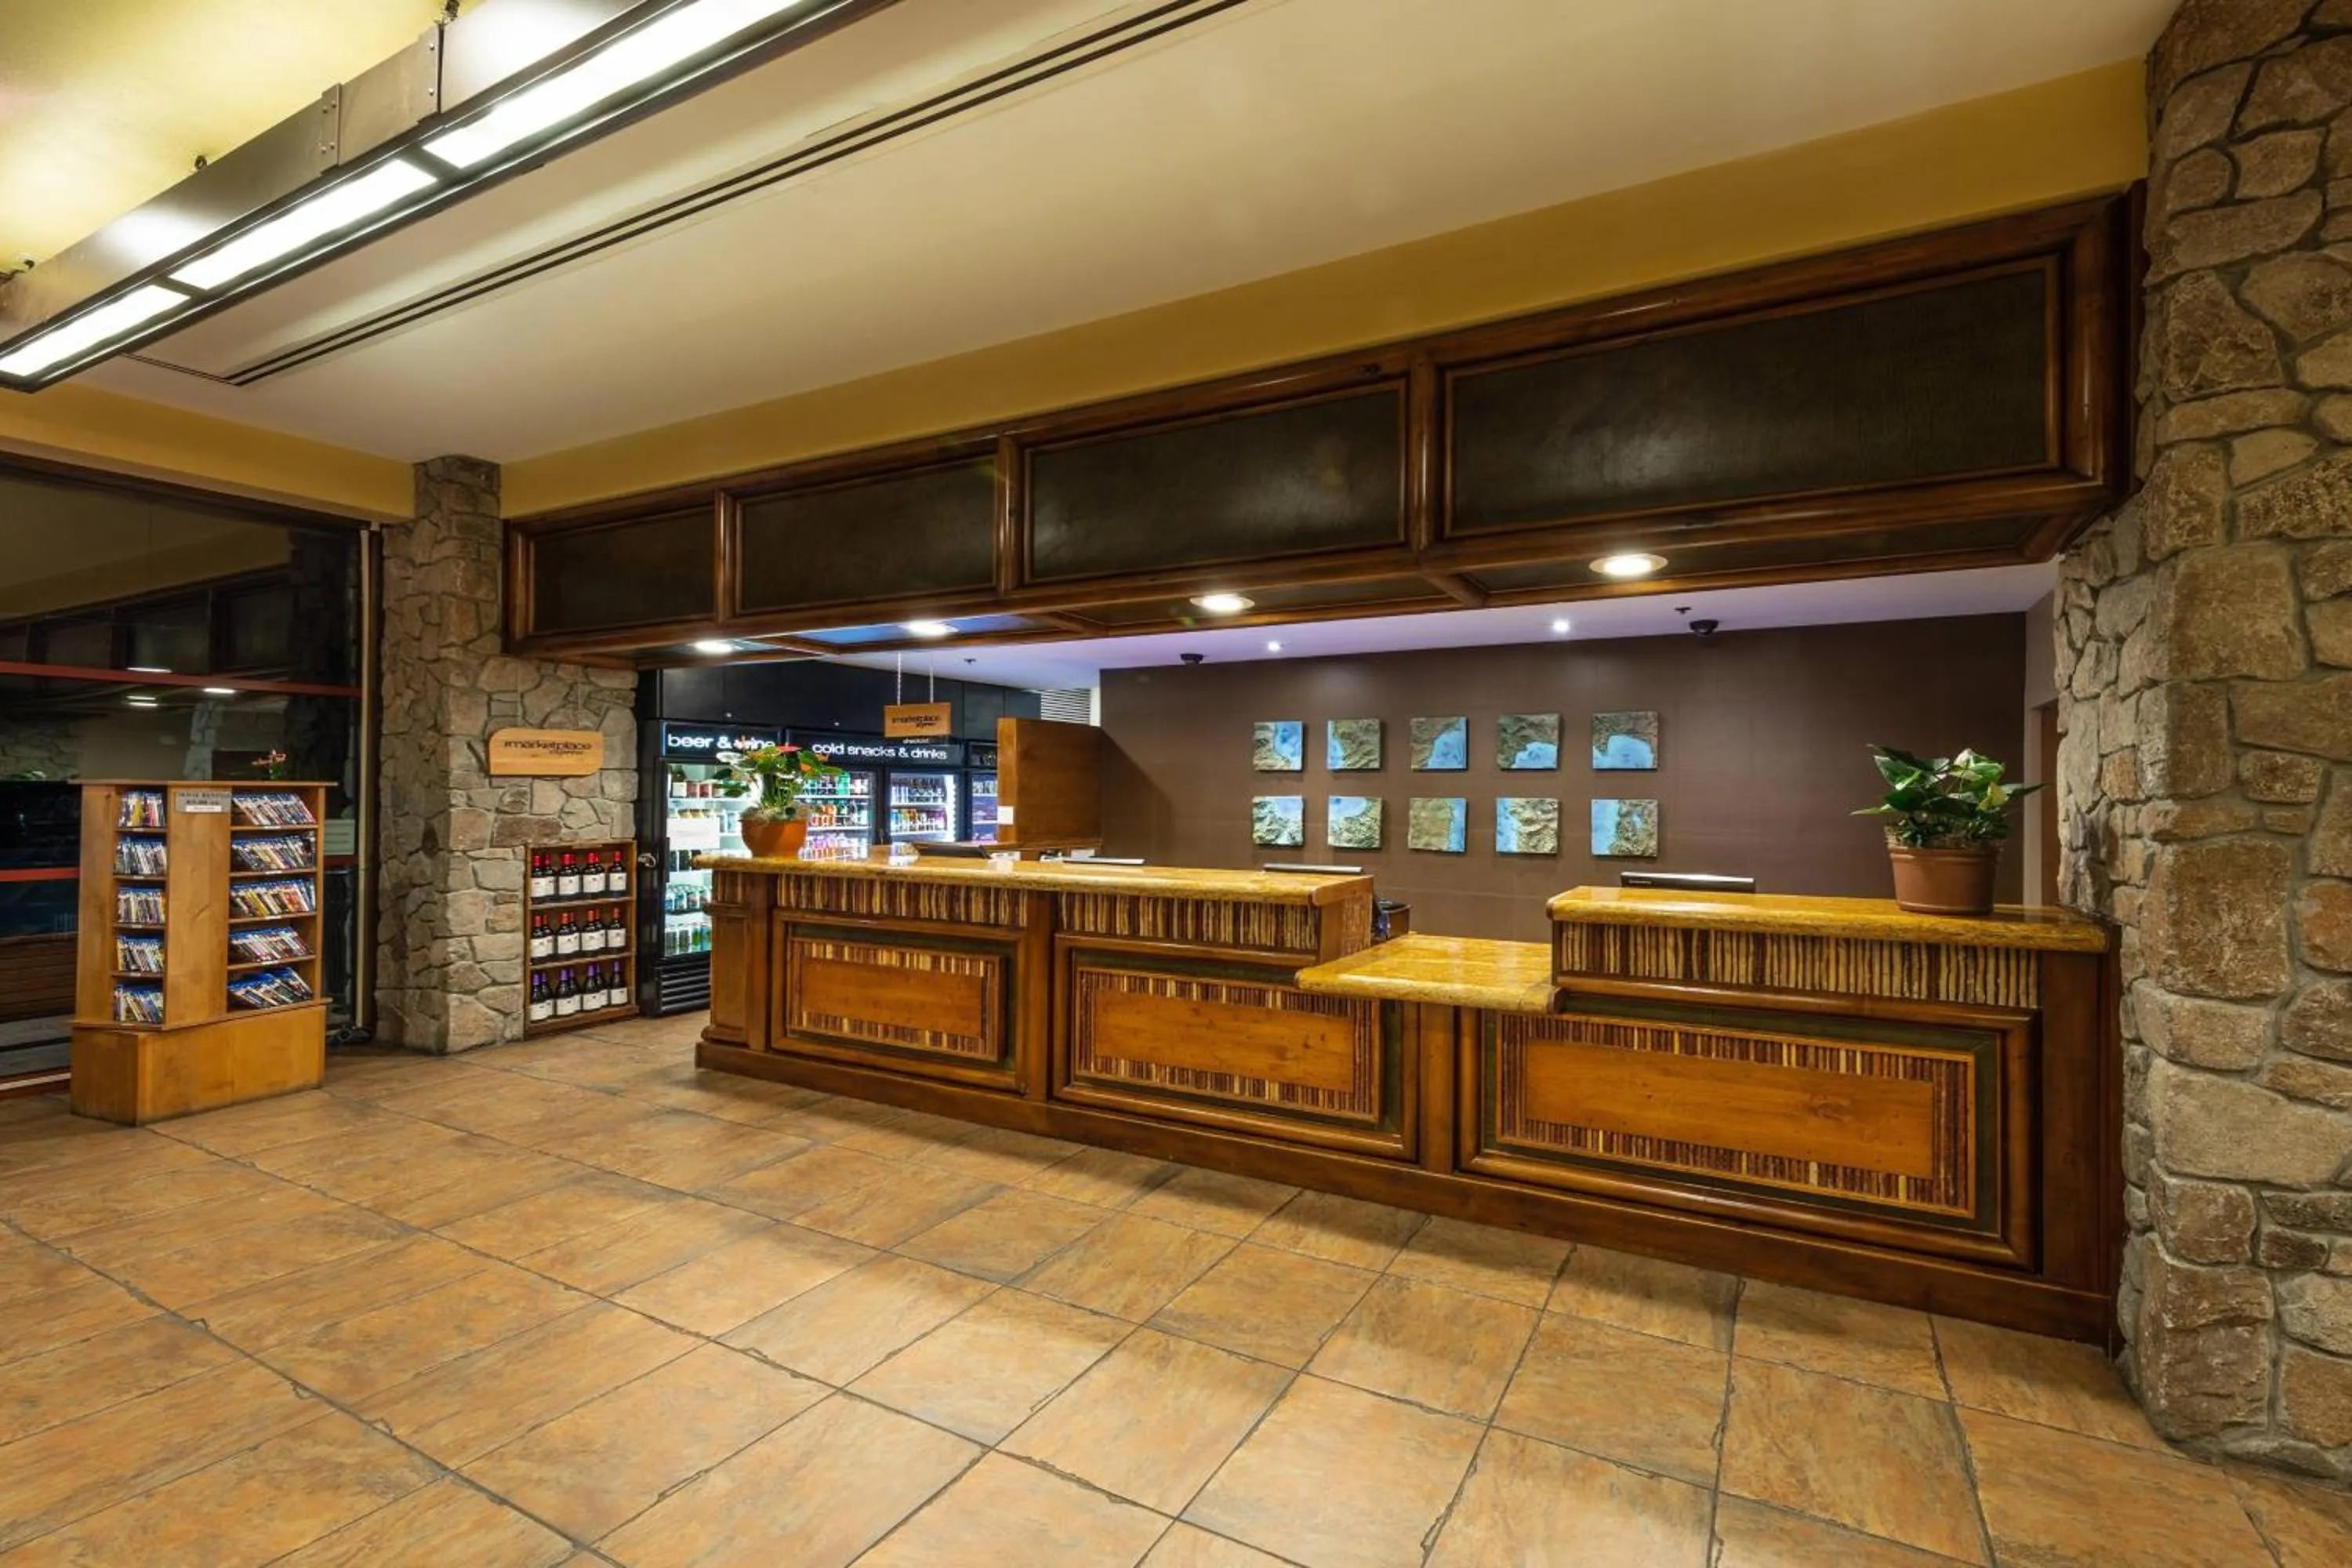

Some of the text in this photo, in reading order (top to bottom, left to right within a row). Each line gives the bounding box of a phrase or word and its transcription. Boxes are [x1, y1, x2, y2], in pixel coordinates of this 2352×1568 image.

[667, 733, 714, 749] beer
[717, 735, 732, 750] &
[811, 742, 948, 760] cold snacks & drinks
